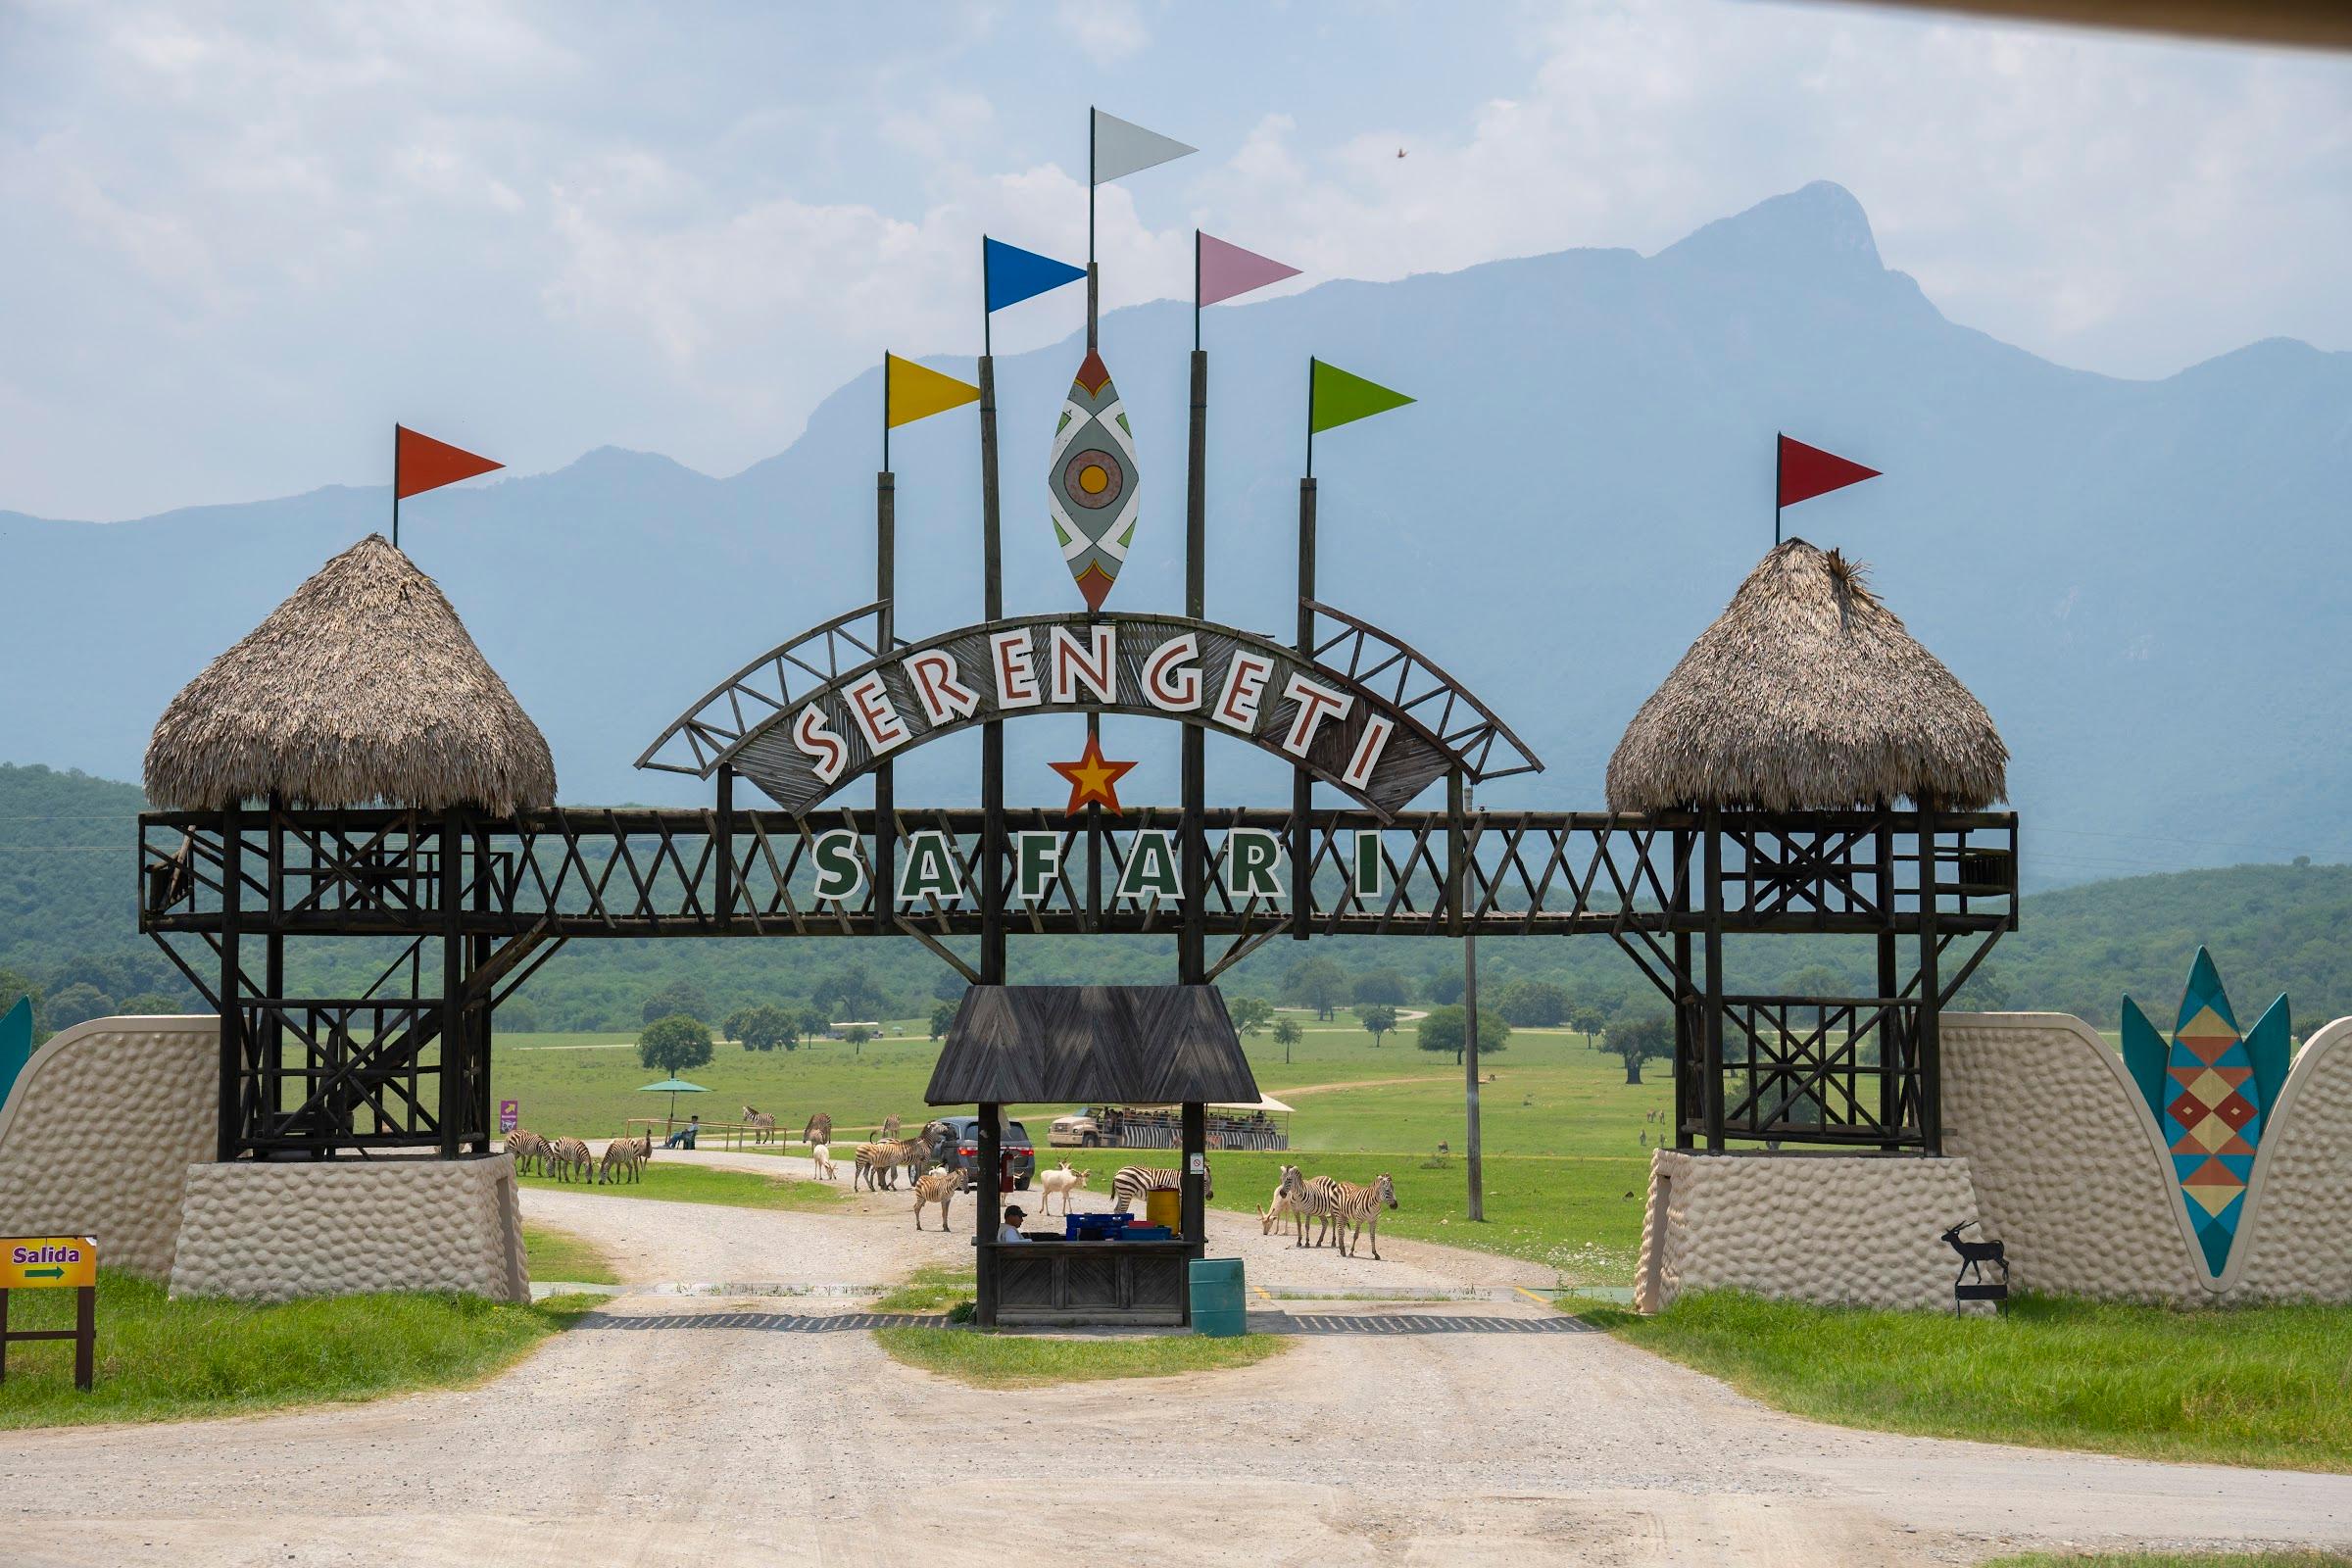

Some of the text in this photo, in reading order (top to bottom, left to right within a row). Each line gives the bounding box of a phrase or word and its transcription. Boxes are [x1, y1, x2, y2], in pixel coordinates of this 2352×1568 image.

[793, 625, 1395, 791] SERENGETI
[812, 829, 1383, 900] SAFARI
[13, 1247, 80, 1263] Salida
